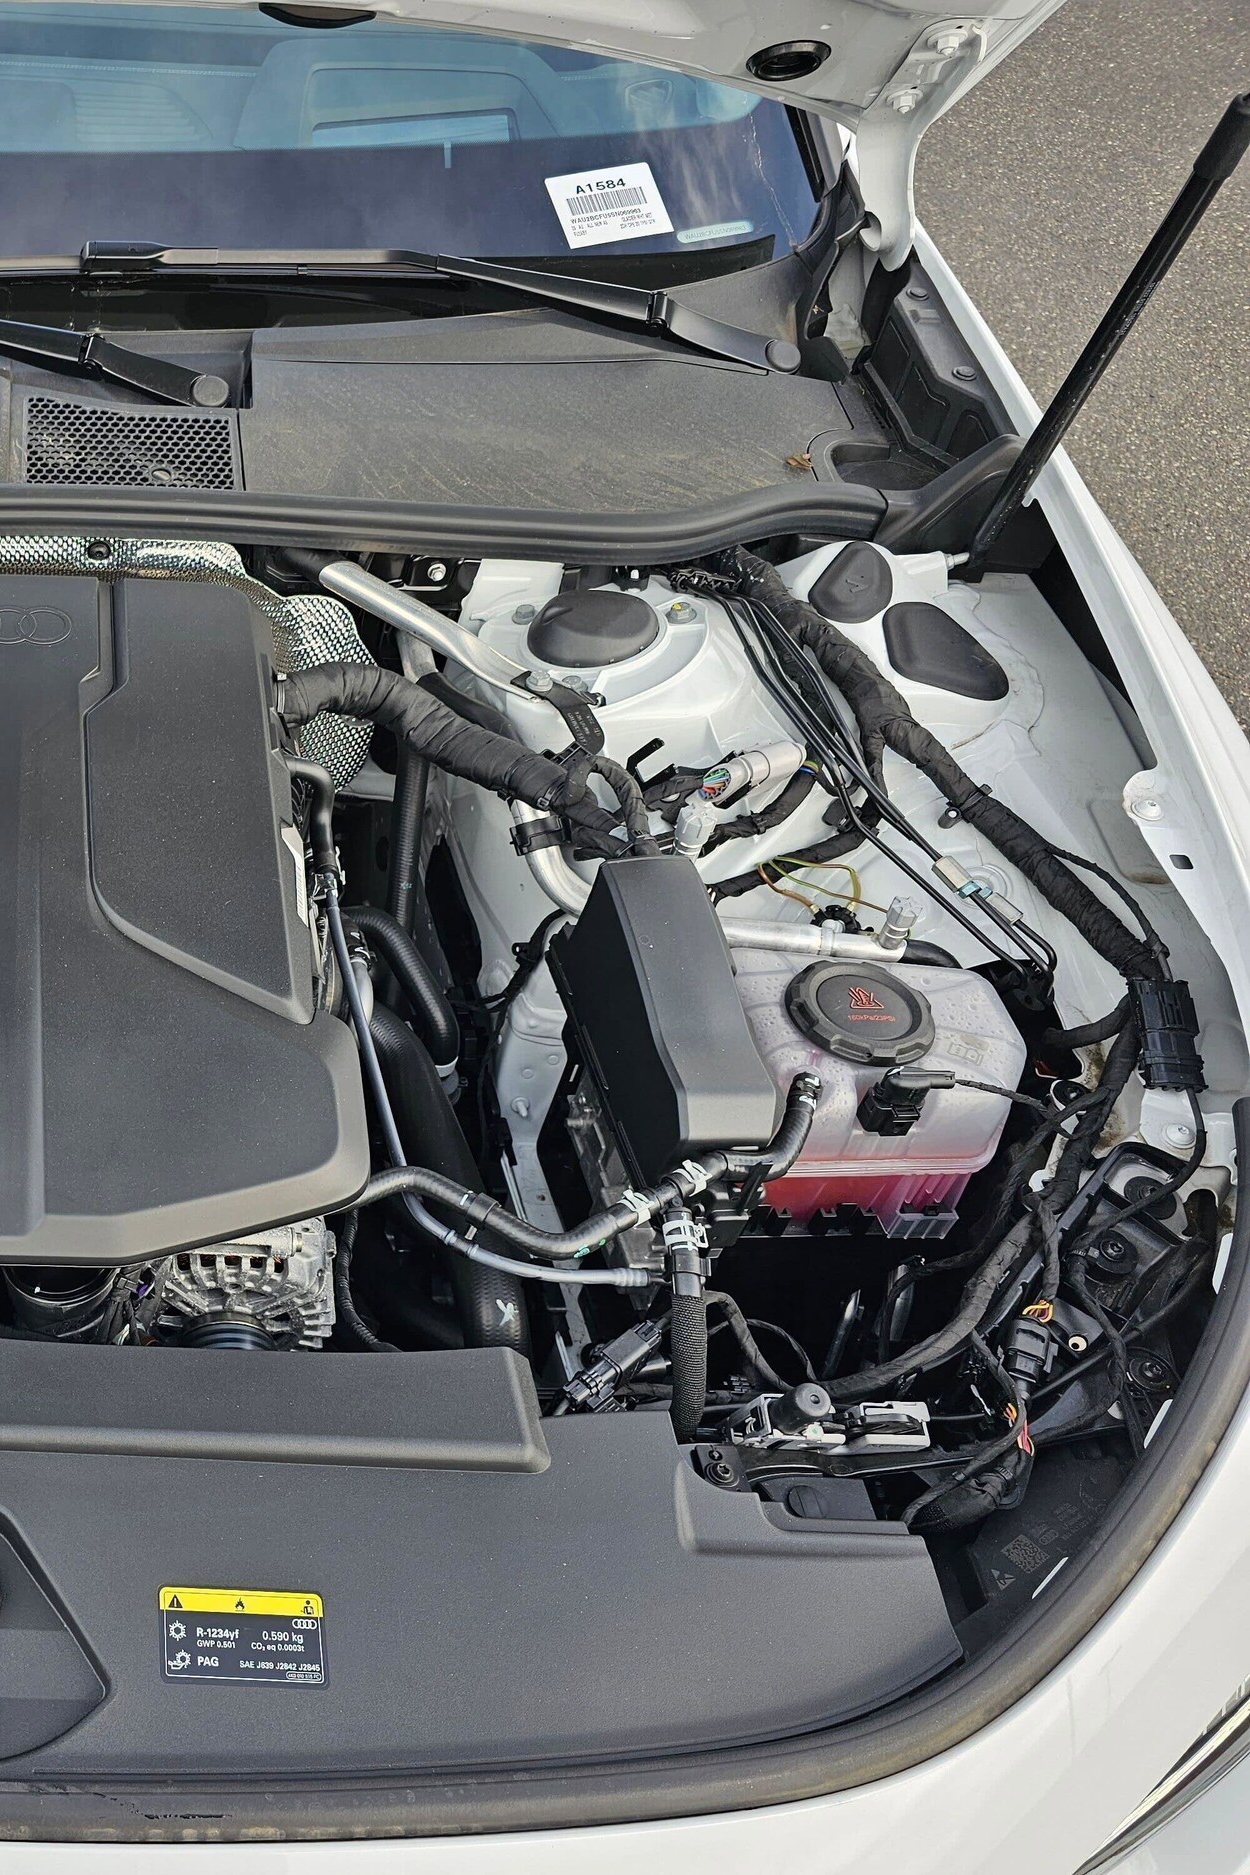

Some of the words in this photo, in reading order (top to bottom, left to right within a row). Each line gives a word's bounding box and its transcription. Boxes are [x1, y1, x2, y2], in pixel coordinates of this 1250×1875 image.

[576, 178, 626, 194] A1584
[196, 1627, 240, 1640] R-1234yf
[262, 1631, 289, 1641] 0.590
[292, 1632, 304, 1644] kg
[196, 1640, 215, 1648] GWP
[277, 1643, 305, 1652] 0.0003t
[197, 1656, 219, 1667] PAG
[239, 1660, 255, 1668] SAE
[256, 1661, 274, 1669] J639
[275, 1662, 297, 1671] J2842
[298, 1663, 320, 1671] J2845
